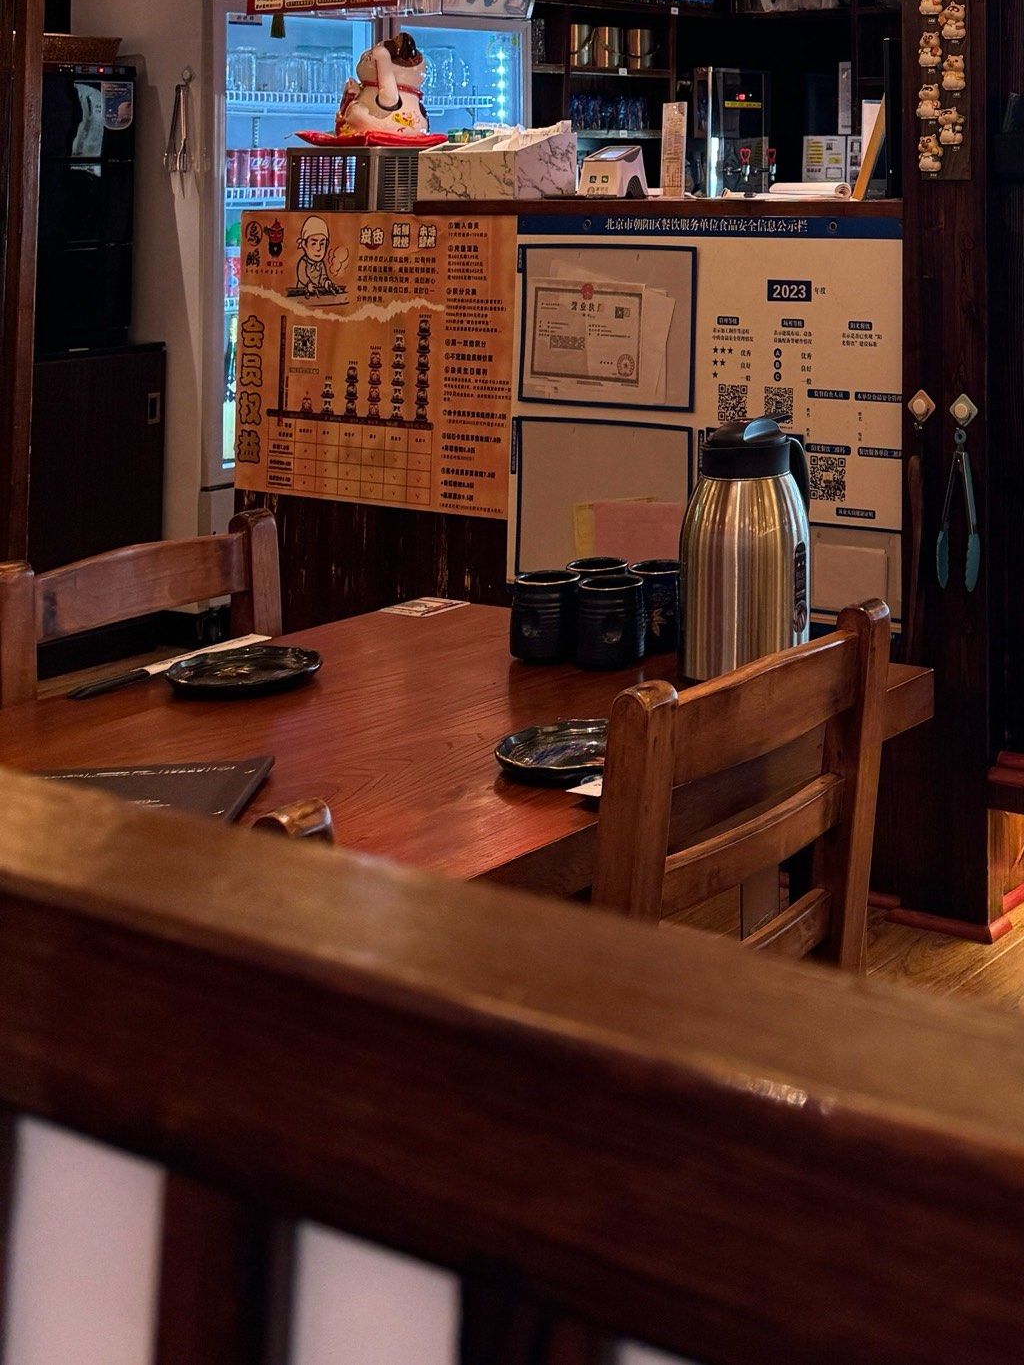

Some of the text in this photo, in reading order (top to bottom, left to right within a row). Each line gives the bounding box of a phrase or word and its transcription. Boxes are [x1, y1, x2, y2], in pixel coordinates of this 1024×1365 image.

[605, 218, 808, 233] 北京市朝阳区餐饮服务单位食品安全信息公示栏
[772, 285, 806, 299] 2023
[237, 314, 265, 465] 会员权益
